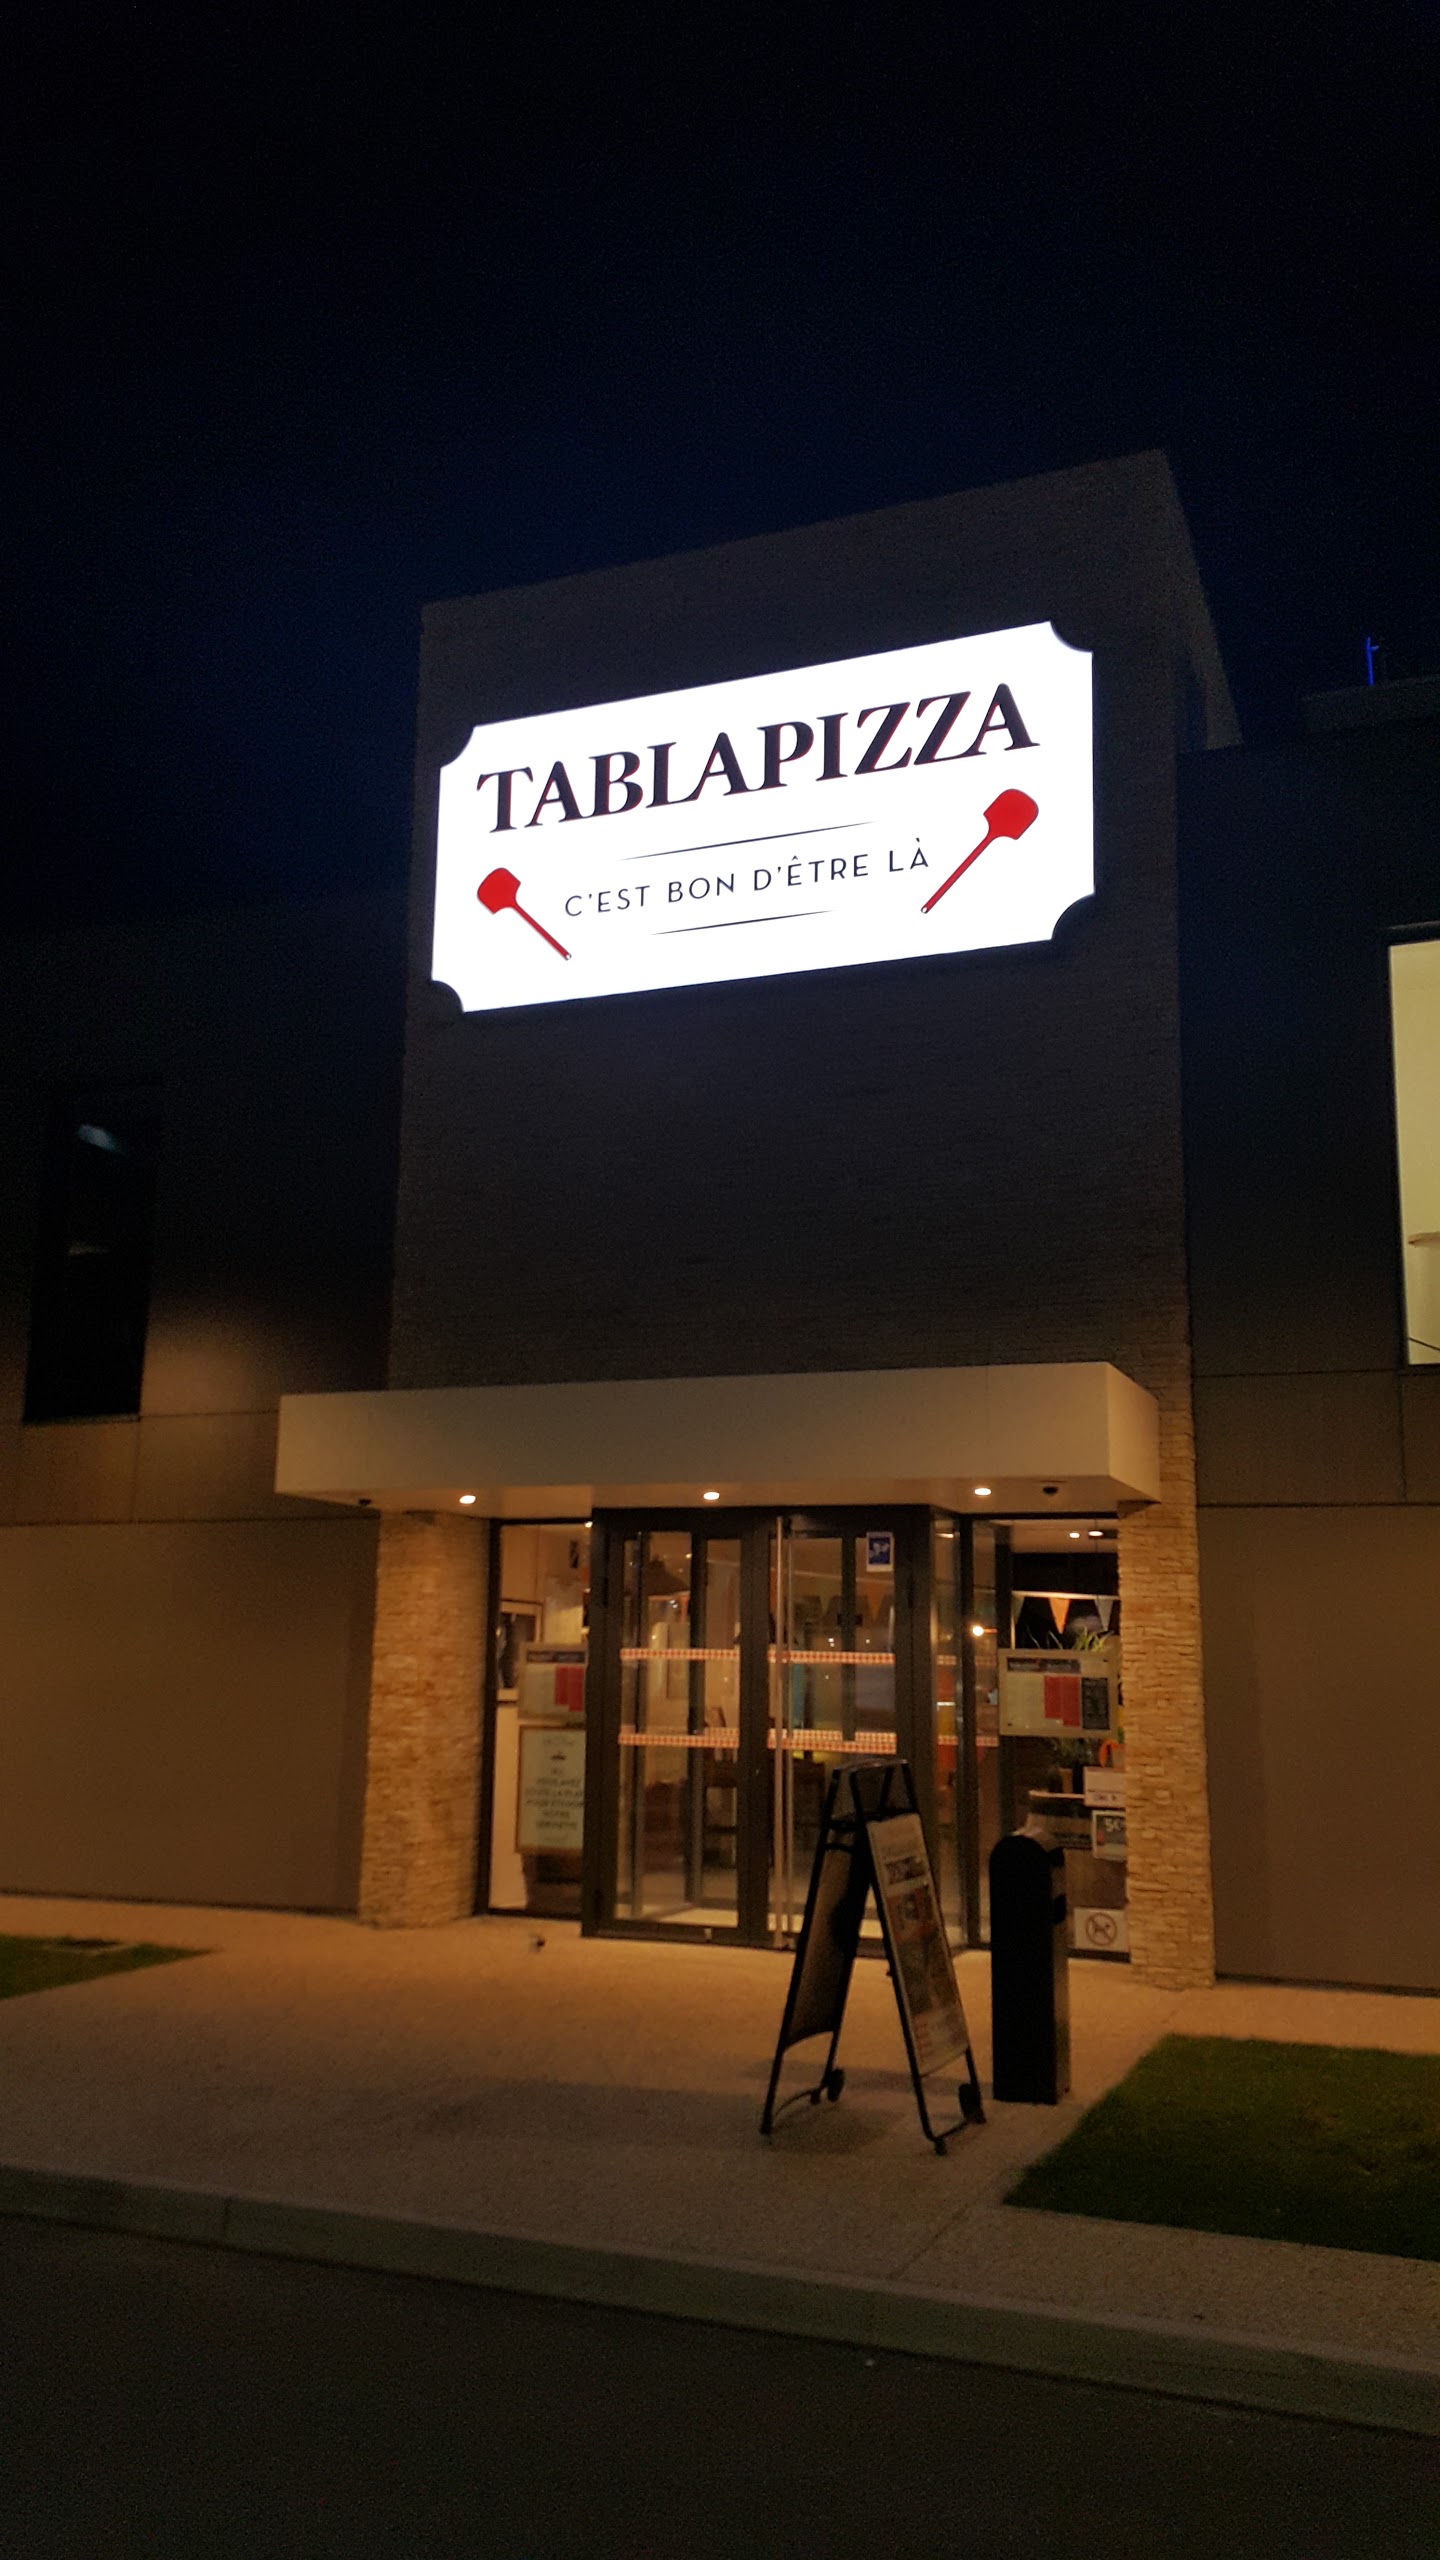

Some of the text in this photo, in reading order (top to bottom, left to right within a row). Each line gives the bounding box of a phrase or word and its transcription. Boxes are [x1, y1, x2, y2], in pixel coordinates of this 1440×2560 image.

[476, 682, 1041, 834] TABLAPIZZA
[564, 837, 929, 917] C'EST BON D'ÊTRE LÀ
